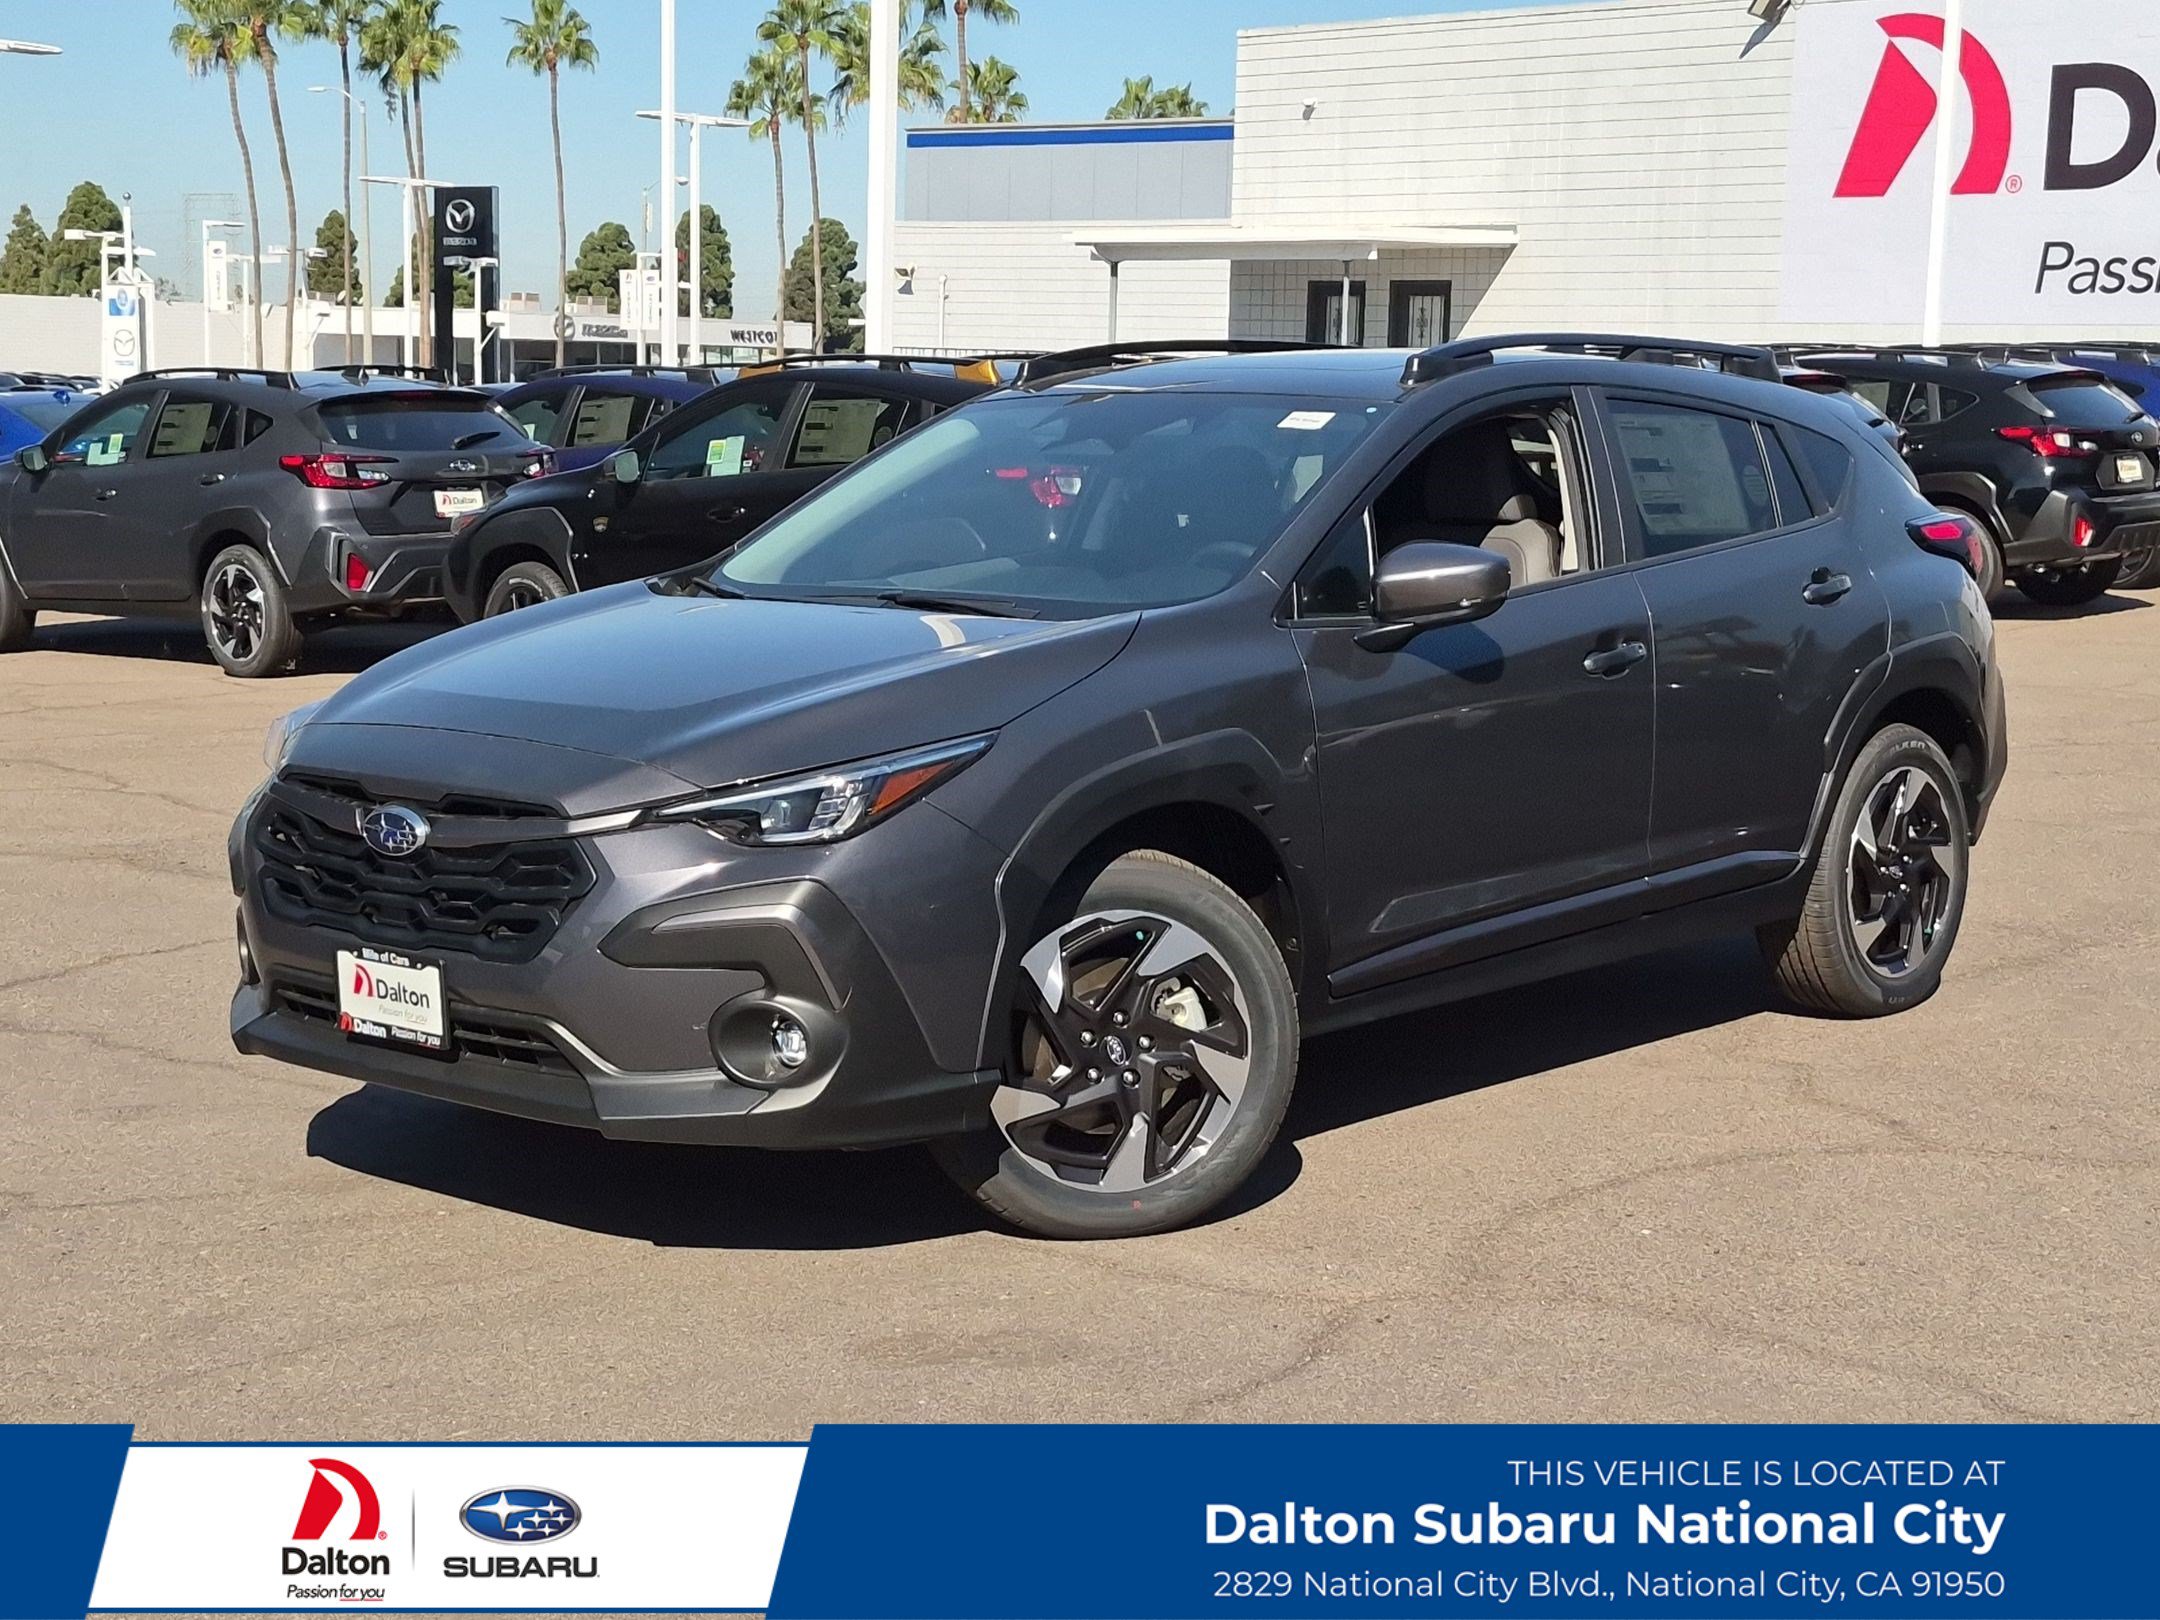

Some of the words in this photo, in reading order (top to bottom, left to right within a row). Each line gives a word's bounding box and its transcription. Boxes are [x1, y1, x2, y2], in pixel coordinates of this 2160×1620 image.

[2043, 63, 2160, 191] D
[376, 978, 430, 1009] Dalton
[353, 1018, 387, 1040] Dalton
